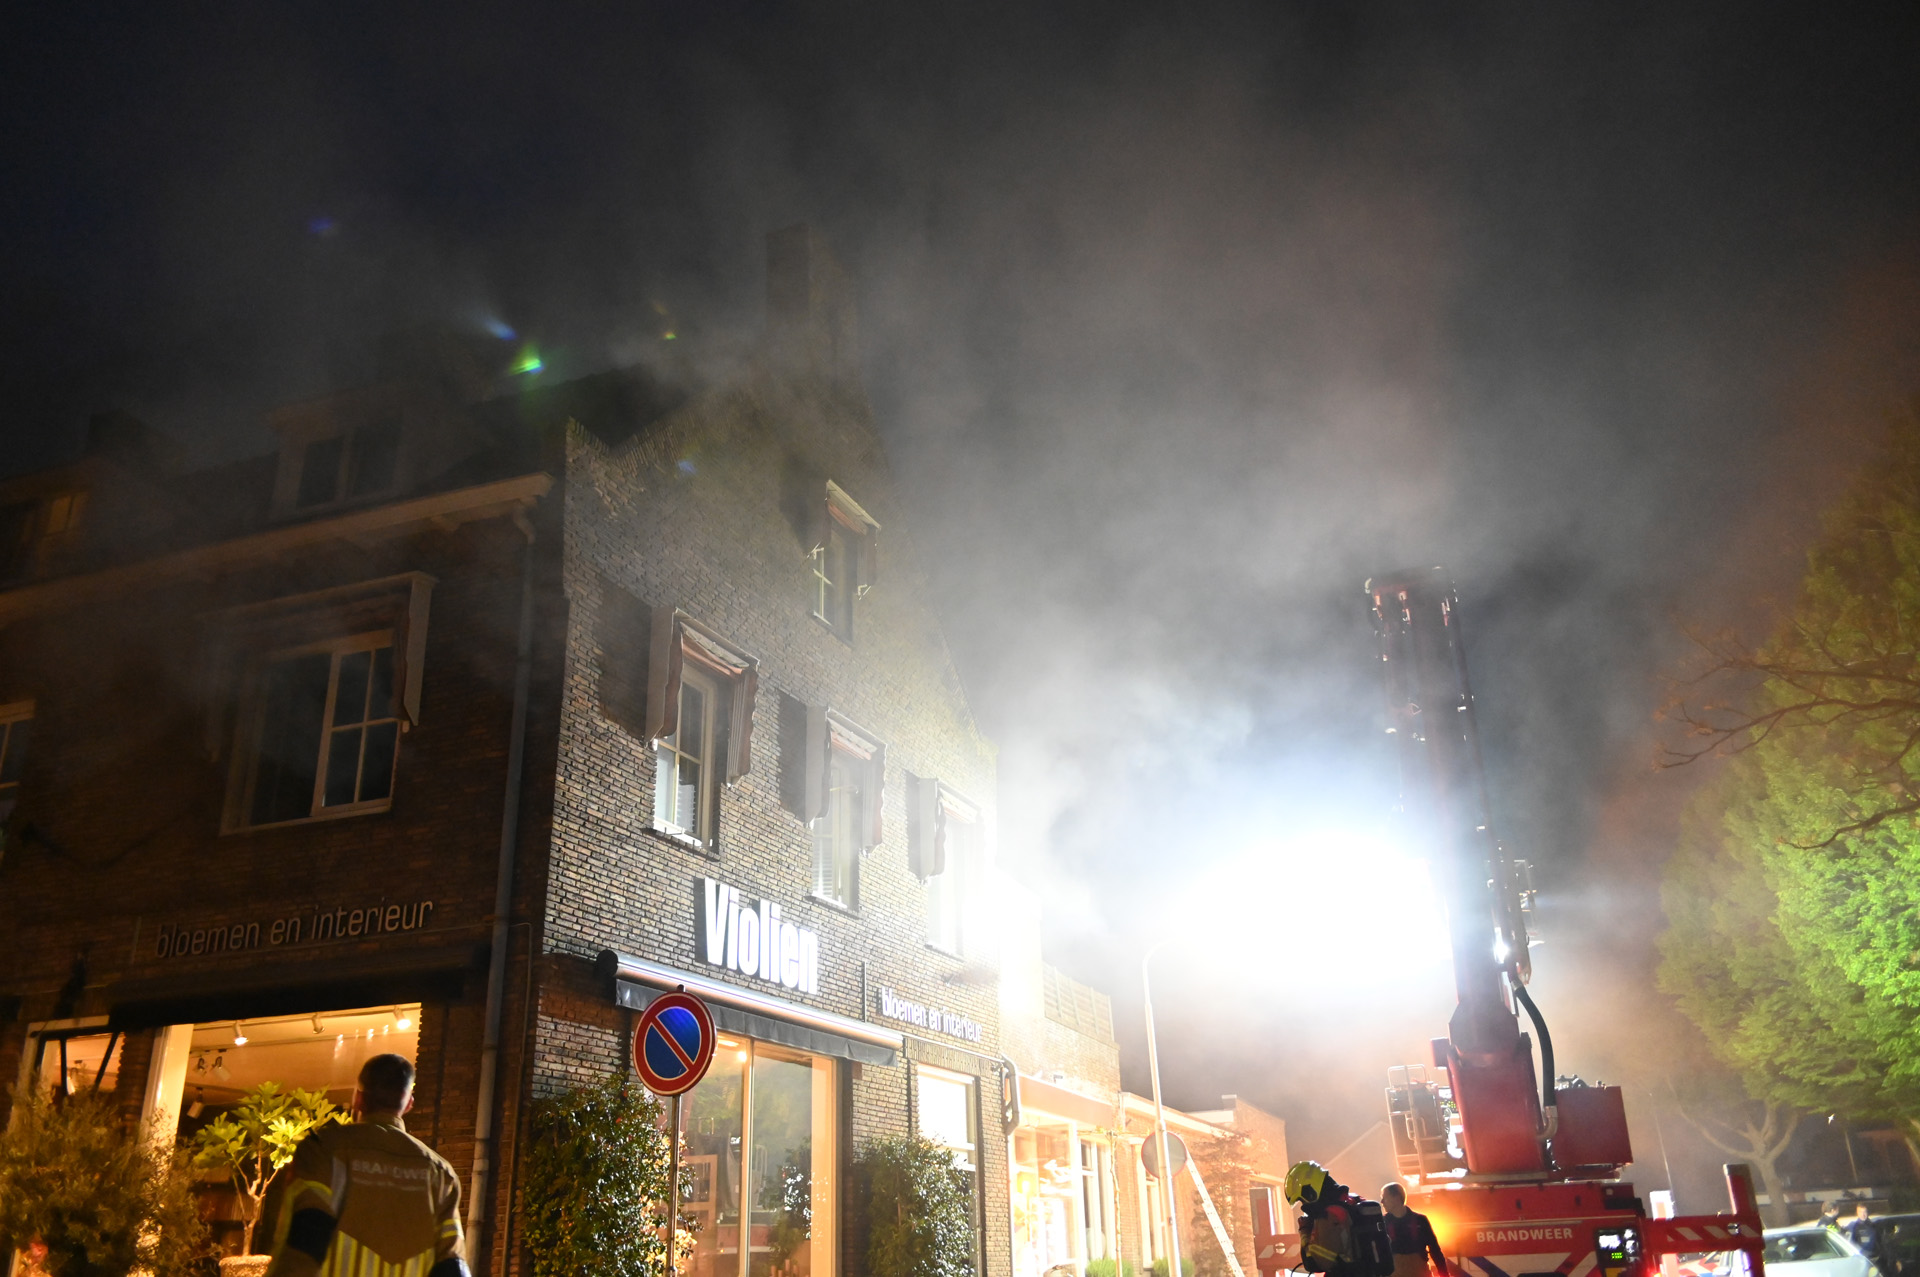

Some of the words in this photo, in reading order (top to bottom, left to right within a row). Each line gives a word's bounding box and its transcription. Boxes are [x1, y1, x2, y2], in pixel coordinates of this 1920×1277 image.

[155, 924, 261, 959] bloemen
[270, 916, 302, 945] en
[311, 897, 434, 939] interieur
[704, 877, 818, 995] Violien
[882, 986, 926, 1027] bloemen
[929, 1008, 941, 1031] en
[943, 1006, 982, 1042] interieur
[1476, 1228, 1573, 1243] BRANDWEER
